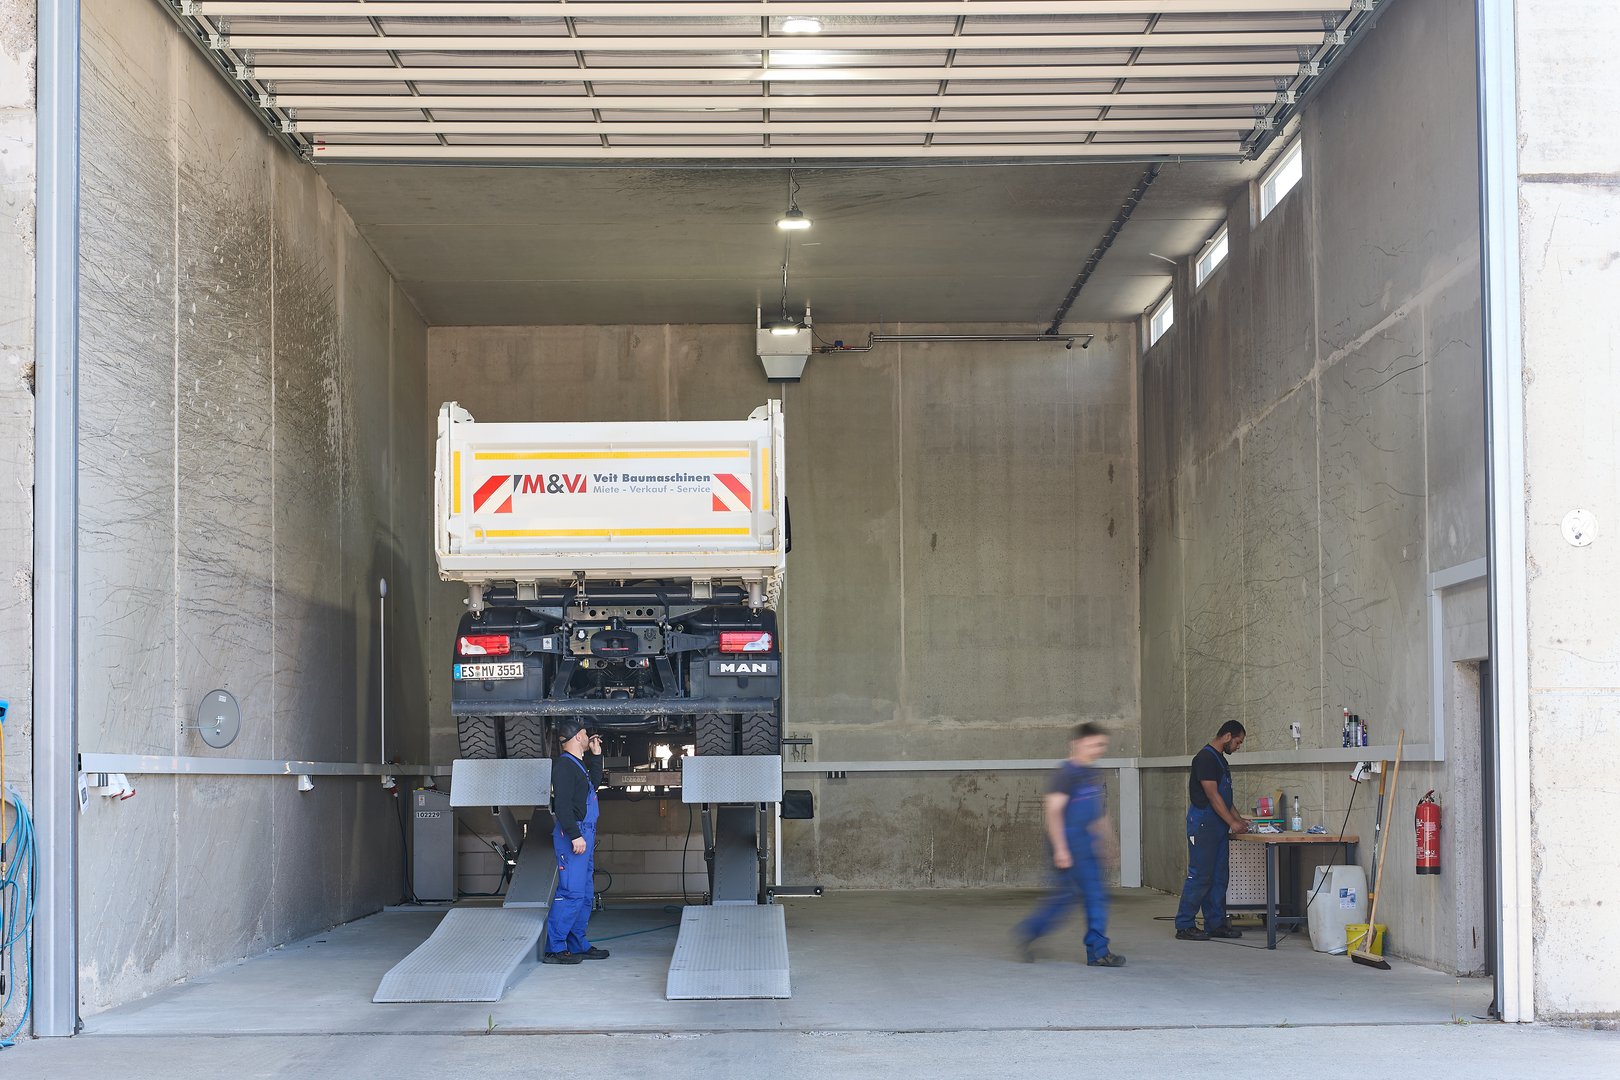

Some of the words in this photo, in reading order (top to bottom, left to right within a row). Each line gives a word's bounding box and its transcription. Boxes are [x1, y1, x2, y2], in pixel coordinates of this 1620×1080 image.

[593, 473, 618, 483] Veit
[622, 473, 711, 483] Baumaschinen
[522, 474, 582, 494] M&V
[593, 485, 620, 493] Miete
[630, 485, 668, 493] Verkauf
[677, 485, 711, 493] Service
[461, 666, 475, 677] ES
[481, 665, 495, 676] MV
[497, 665, 523, 676] 3551
[720, 663, 767, 673] MAN
